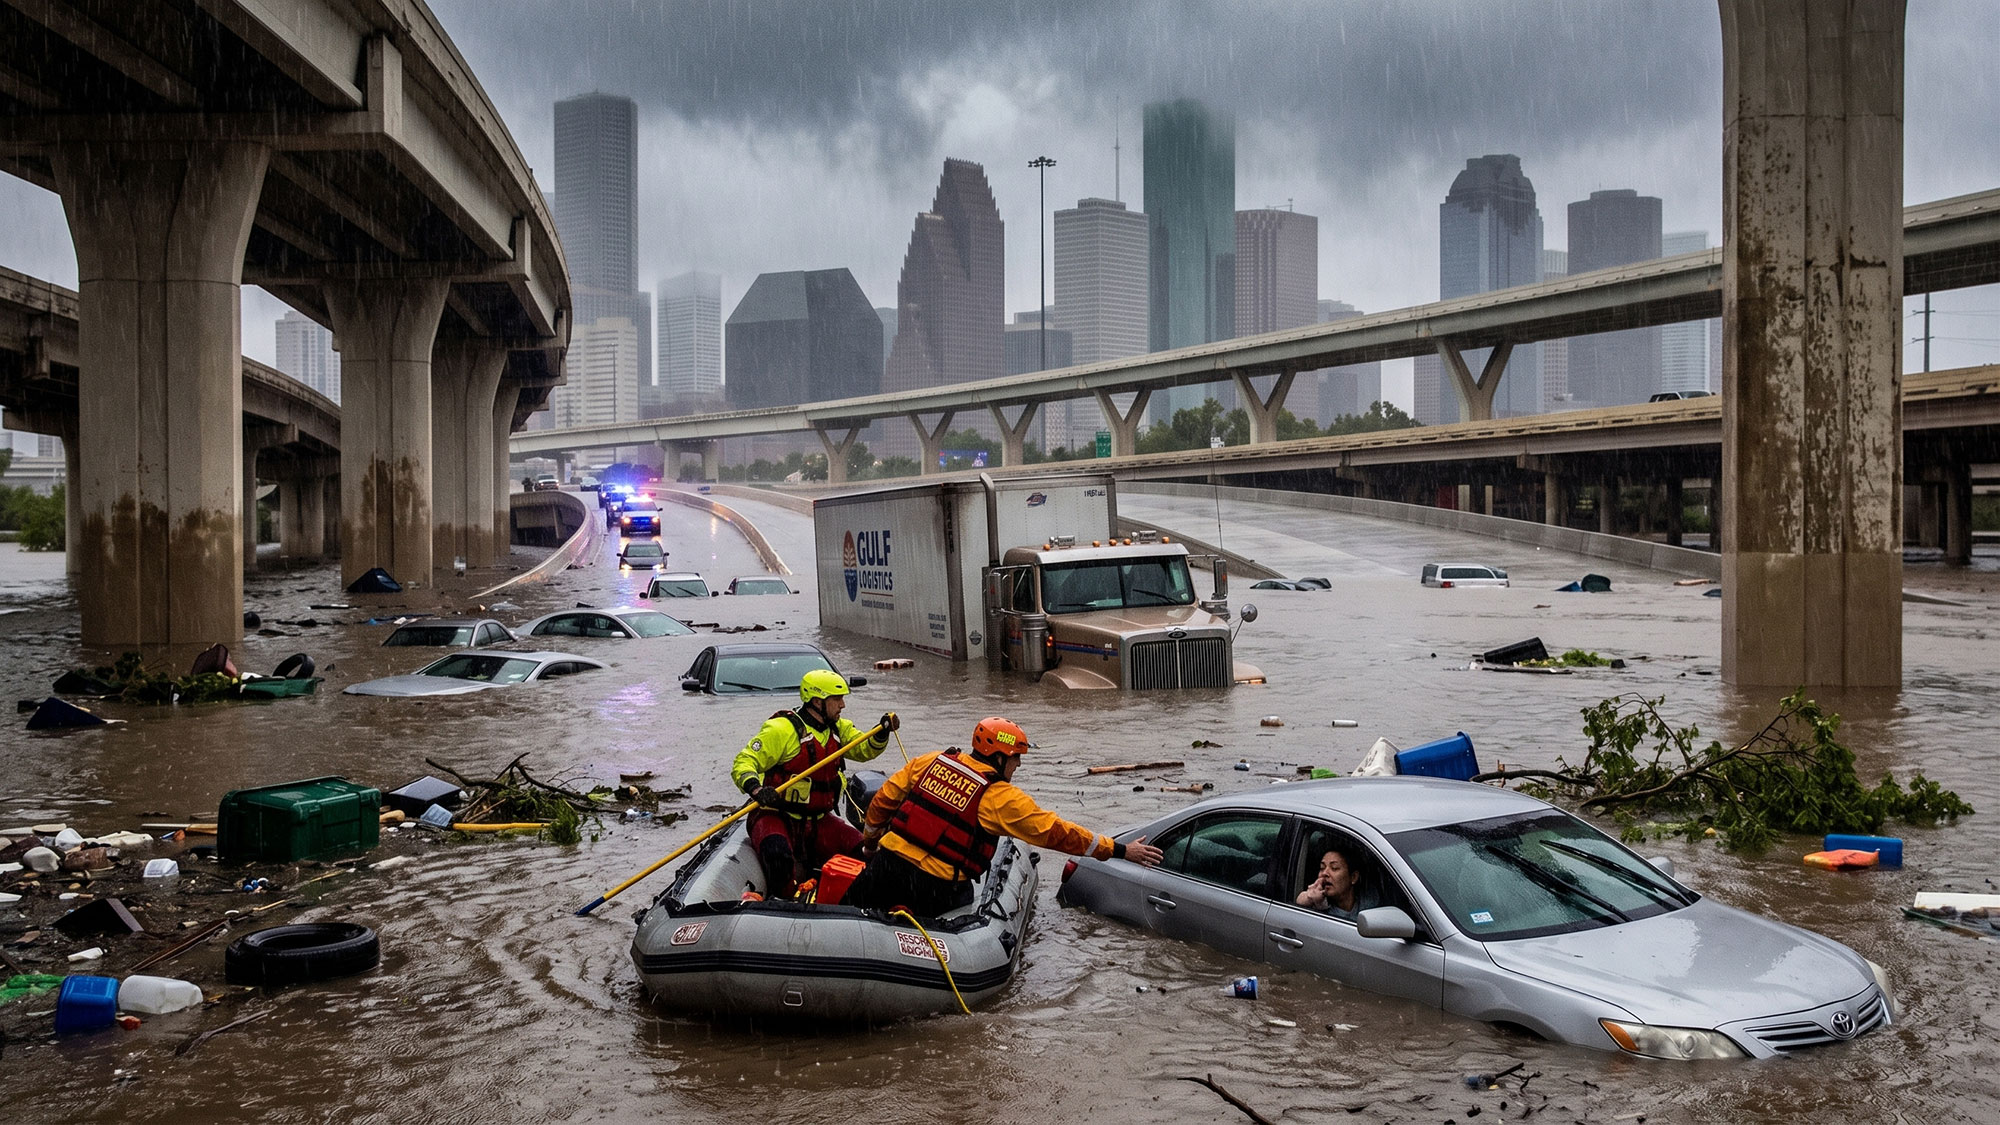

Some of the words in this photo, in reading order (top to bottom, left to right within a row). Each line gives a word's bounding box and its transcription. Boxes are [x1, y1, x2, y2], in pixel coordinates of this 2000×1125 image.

[857, 530, 891, 566] GULF
[859, 570, 893, 591] LOGISTICS
[930, 763, 977, 795] RESCATE
